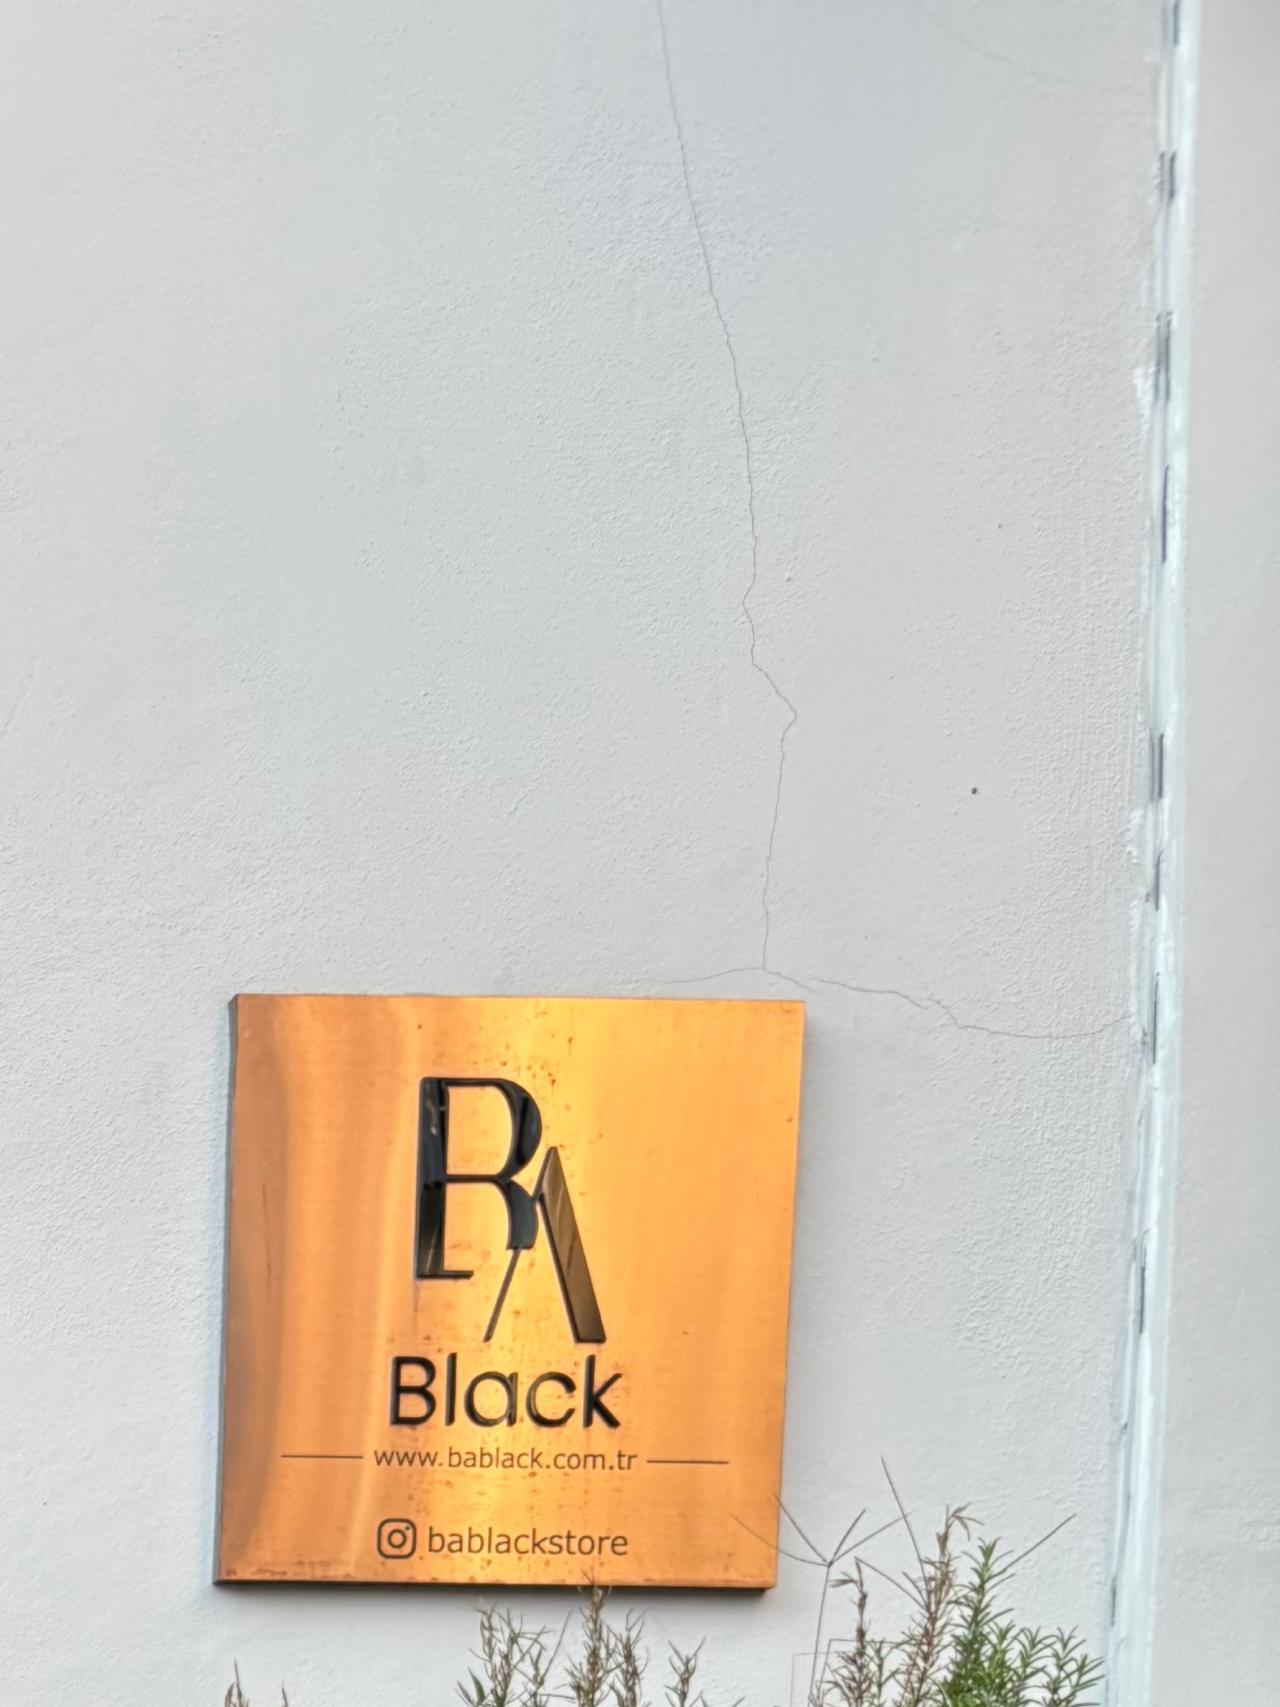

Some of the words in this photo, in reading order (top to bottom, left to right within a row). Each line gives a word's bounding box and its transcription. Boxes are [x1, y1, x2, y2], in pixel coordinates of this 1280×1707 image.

[389, 1352, 624, 1429] Black
[373, 1446, 638, 1471] www.bablack.com.tr
[427, 1526, 629, 1556] bablackstore
